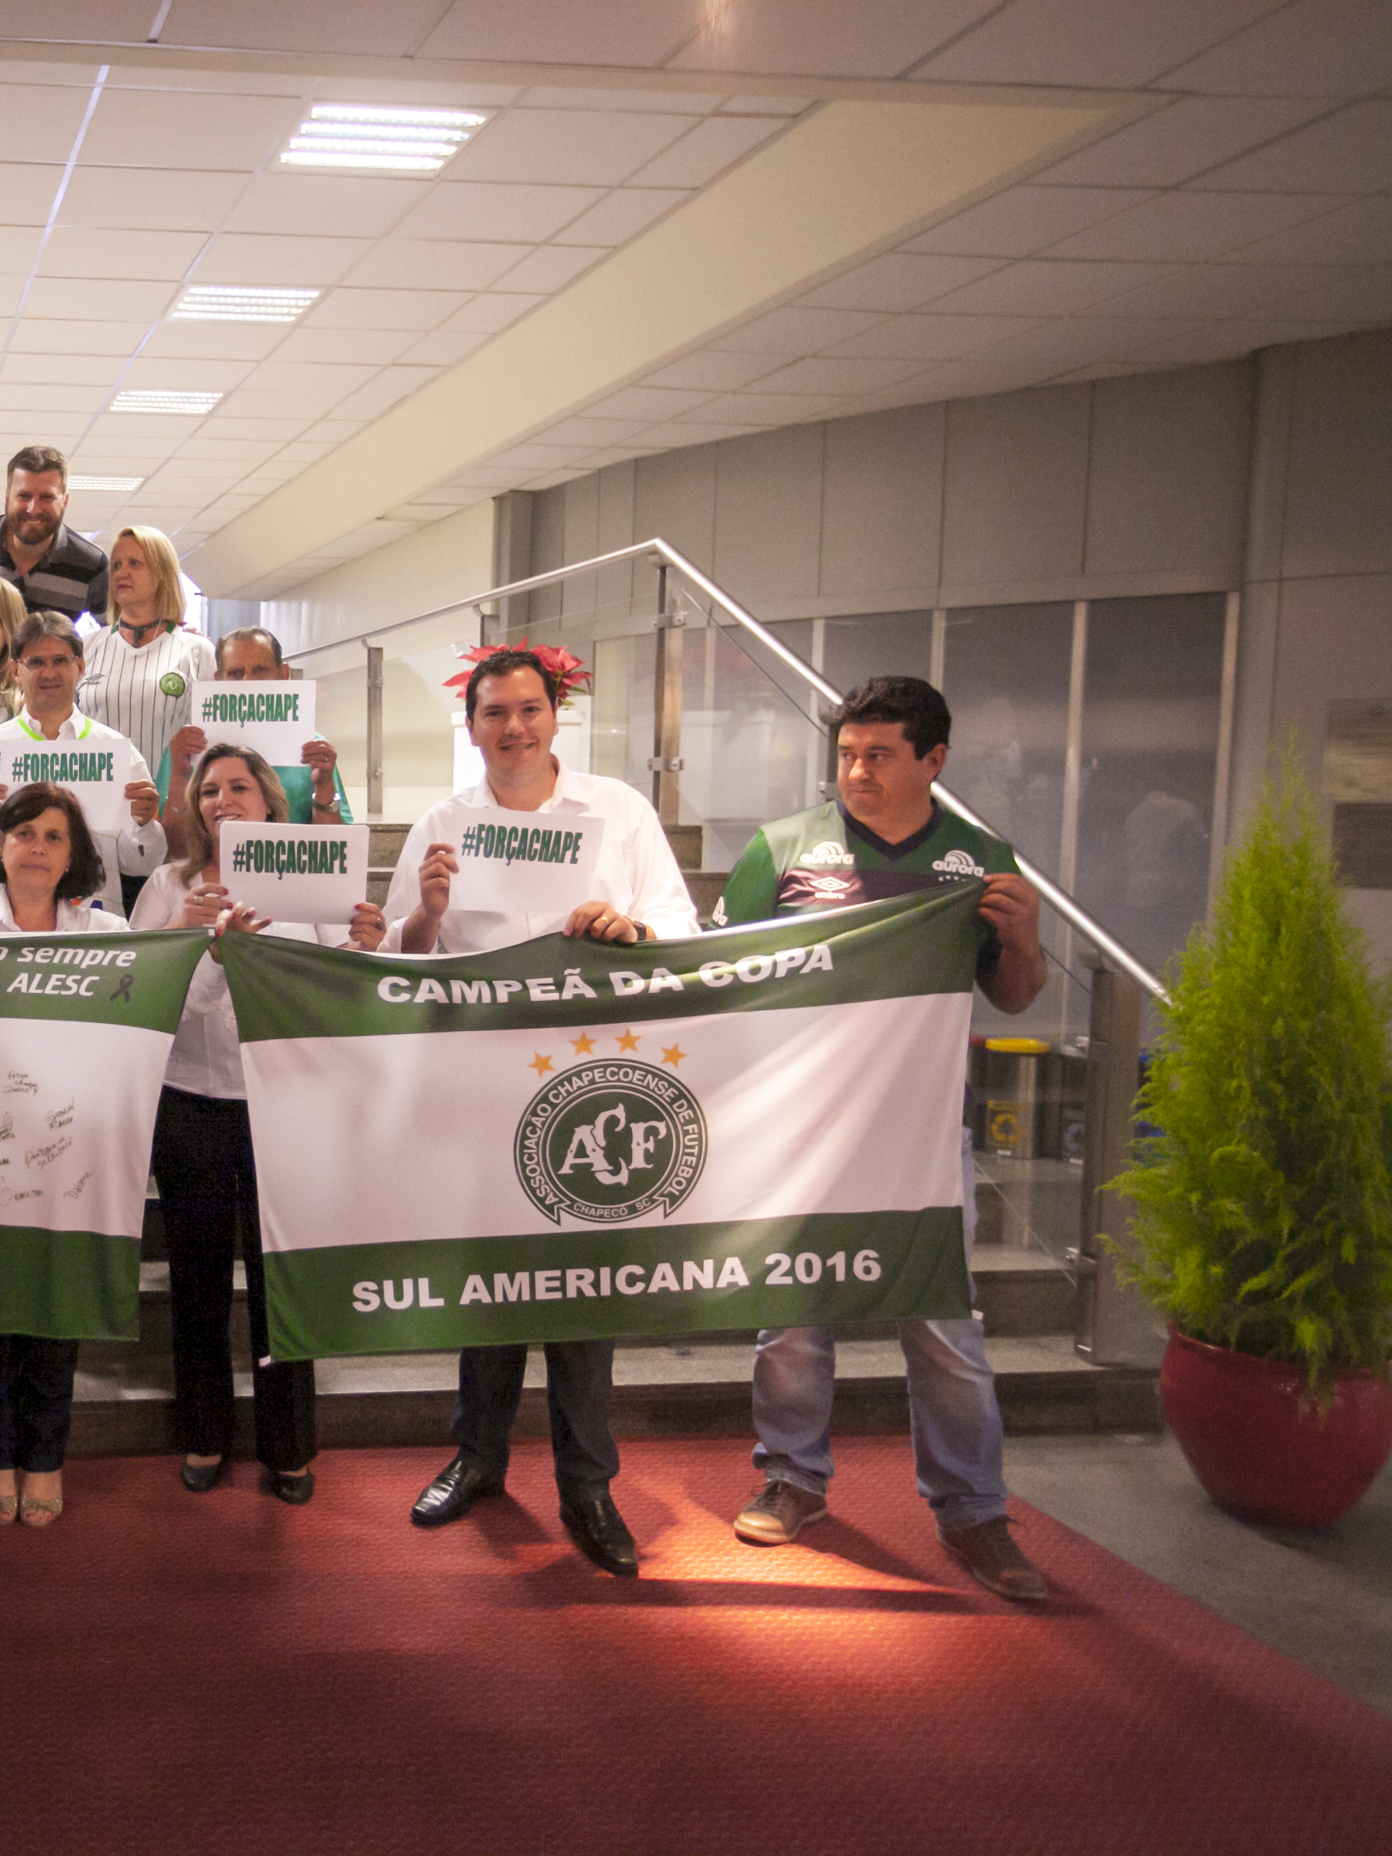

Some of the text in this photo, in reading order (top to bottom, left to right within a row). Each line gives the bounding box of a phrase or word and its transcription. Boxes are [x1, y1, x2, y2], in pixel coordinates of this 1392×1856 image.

[201, 693, 299, 728] #FORÇACHAPE
[232, 839, 348, 881] #FORÇACHAPE
[461, 823, 584, 866] #FORÇACHAPE
[814, 890, 845, 900] umbro
[16, 946, 137, 969] sempre
[377, 943, 835, 1005] CAMPEÃ DA COPA
[6, 972, 101, 997] ALESC
[523, 1066, 699, 1206] ASSOCIAÇÃO CHAPECOENSE DE FUTEBOL
[635, 1197, 652, 1211] SC
[352, 1248, 882, 1313] SUL AMERICANA 2016
